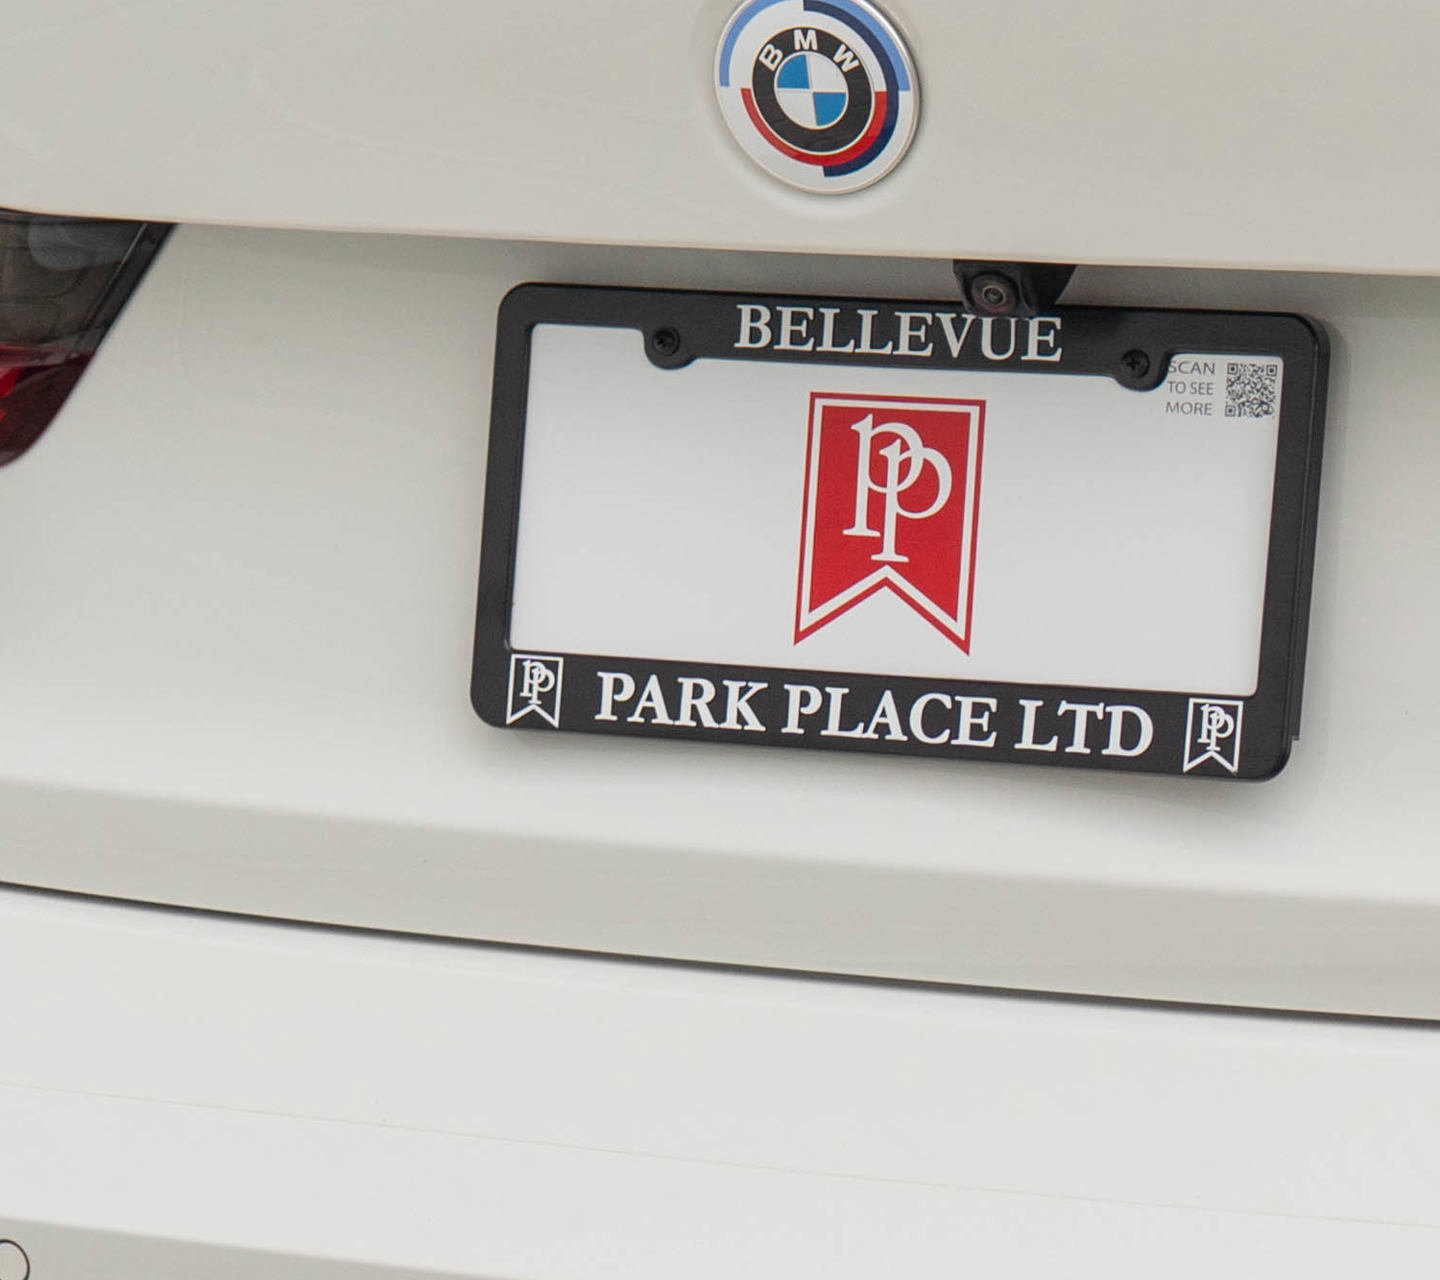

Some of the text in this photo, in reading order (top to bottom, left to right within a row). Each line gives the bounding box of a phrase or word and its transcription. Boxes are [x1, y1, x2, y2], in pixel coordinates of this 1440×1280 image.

[758, 28, 861, 73] BMW
[734, 304, 1062, 362] BELLEVUE
[1168, 360, 1216, 376] SCAN
[1168, 380, 1214, 396] TO SEE
[1165, 401, 1213, 416] MORE
[594, 671, 1155, 757] PARK PLACE LTD
